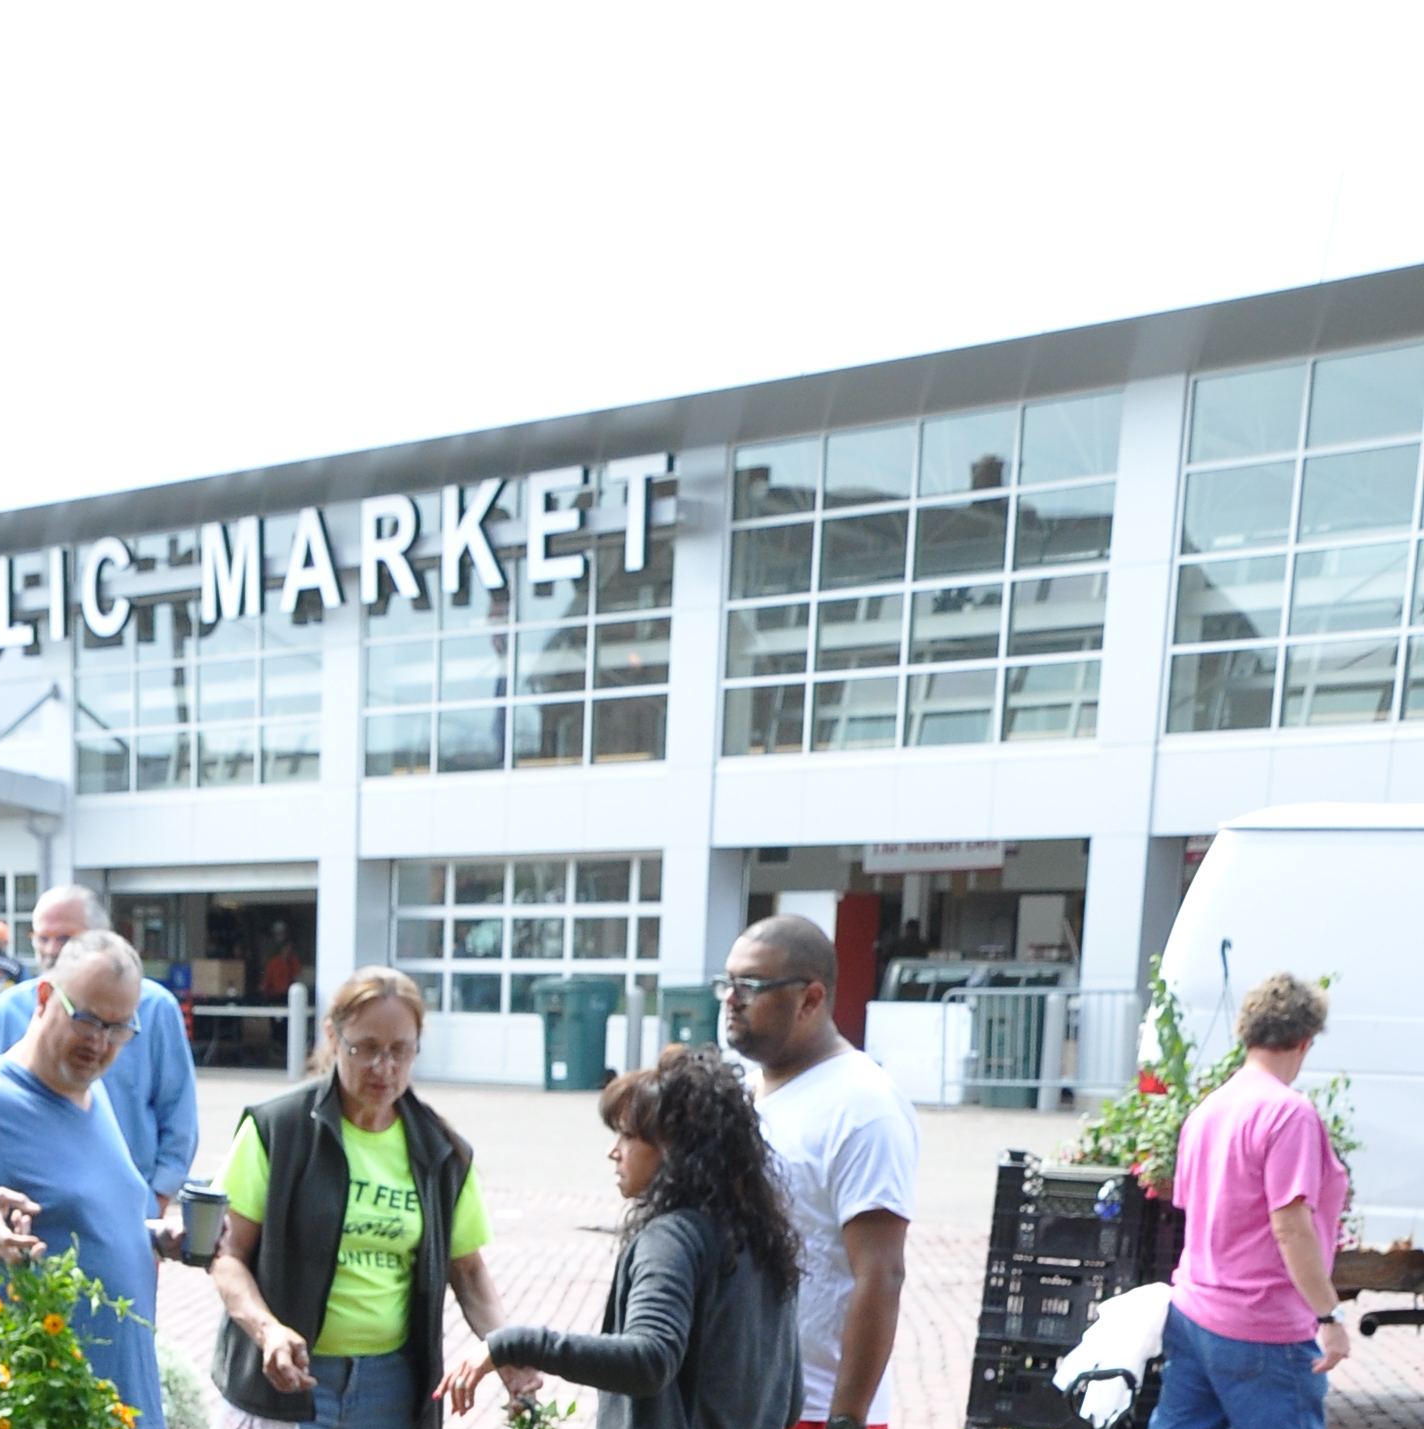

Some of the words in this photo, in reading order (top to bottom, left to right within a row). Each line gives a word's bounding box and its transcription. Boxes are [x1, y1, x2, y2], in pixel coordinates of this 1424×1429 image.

[201, 452, 669, 624] MARKET
[349, 1180, 369, 1203] T
[372, 1184, 419, 1213] FEE
